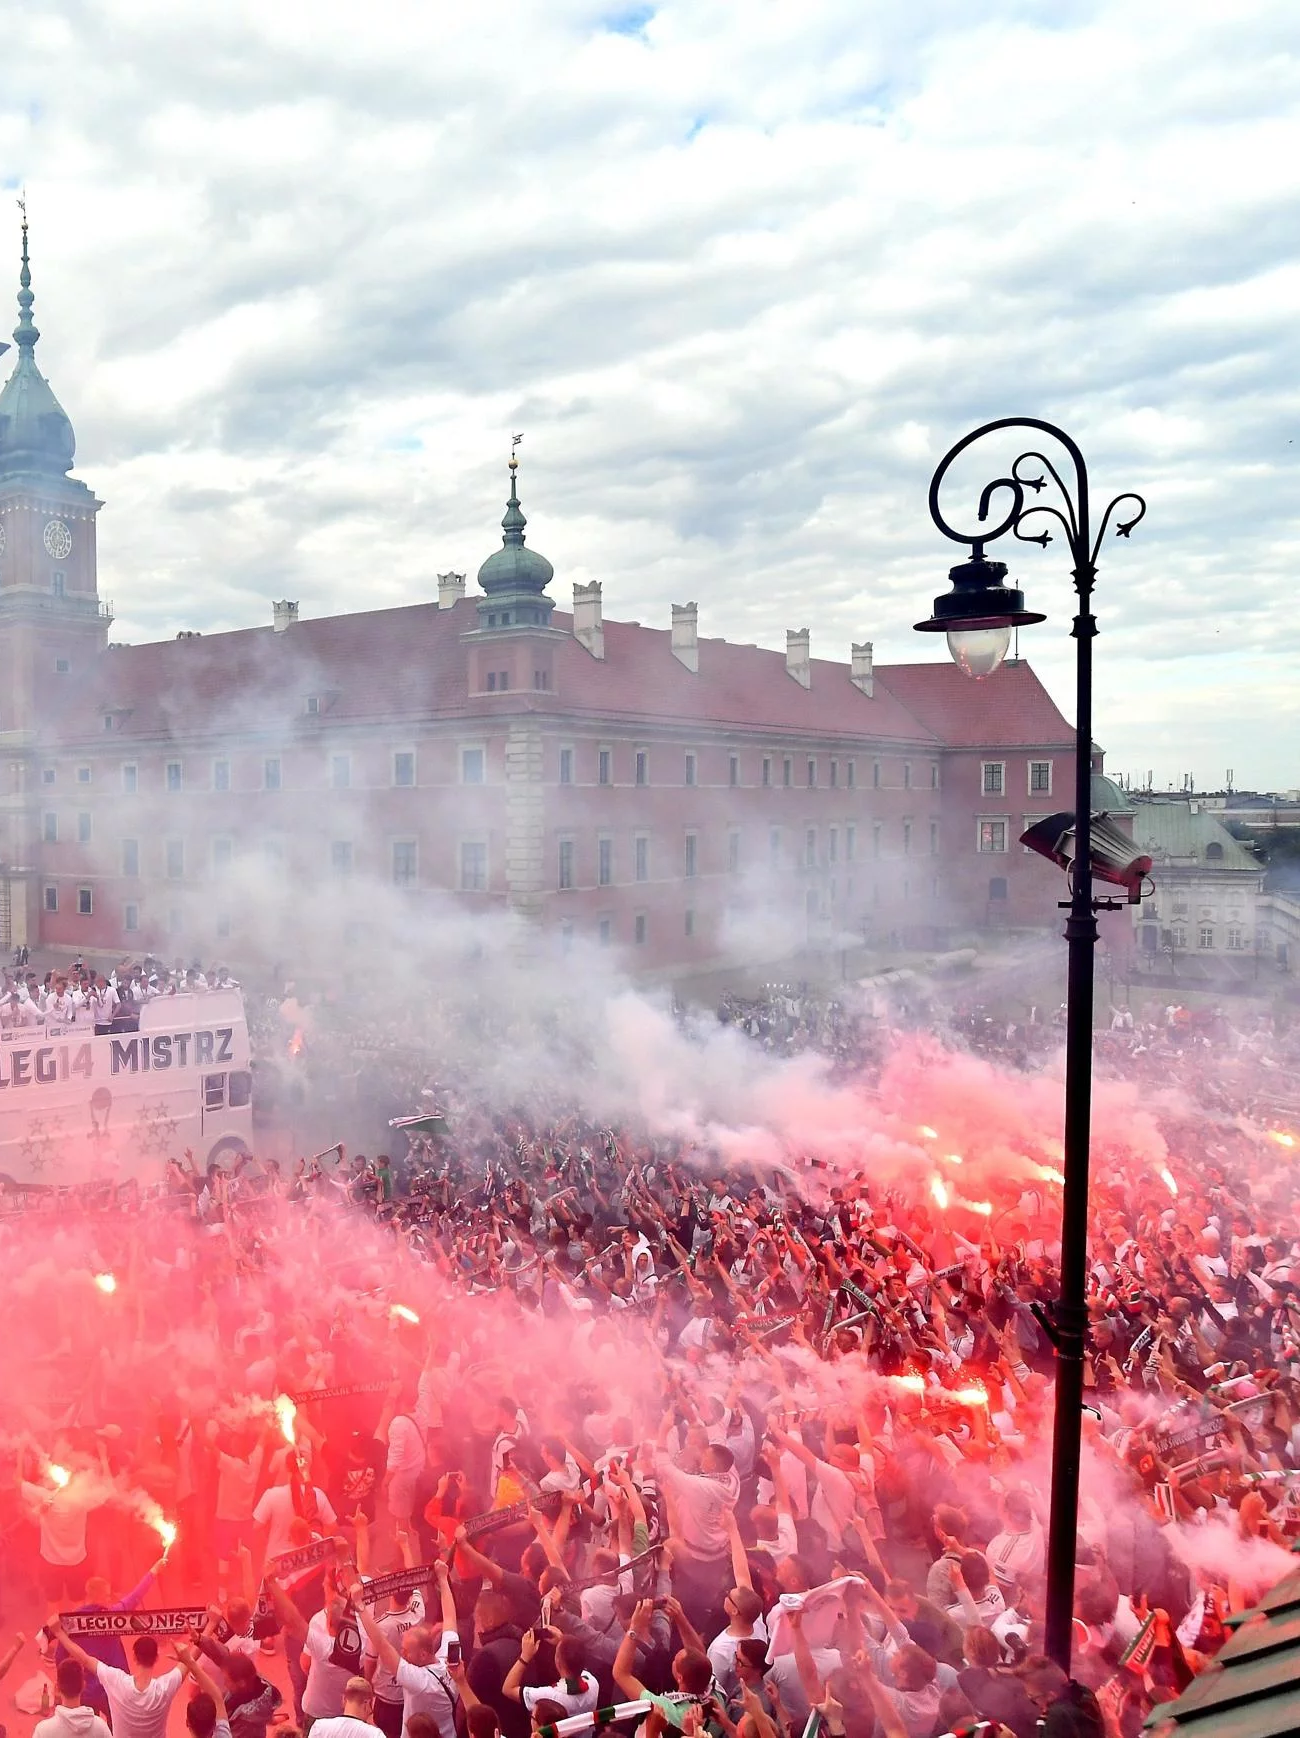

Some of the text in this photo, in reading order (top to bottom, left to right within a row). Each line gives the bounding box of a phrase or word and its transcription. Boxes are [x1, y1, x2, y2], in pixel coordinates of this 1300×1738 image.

[110, 1028, 234, 1075] MISTRZ
[280, 1546, 325, 1571] CWKS
[77, 1615, 127, 1631] LEGIO
[342, 1629, 354, 1651] L
